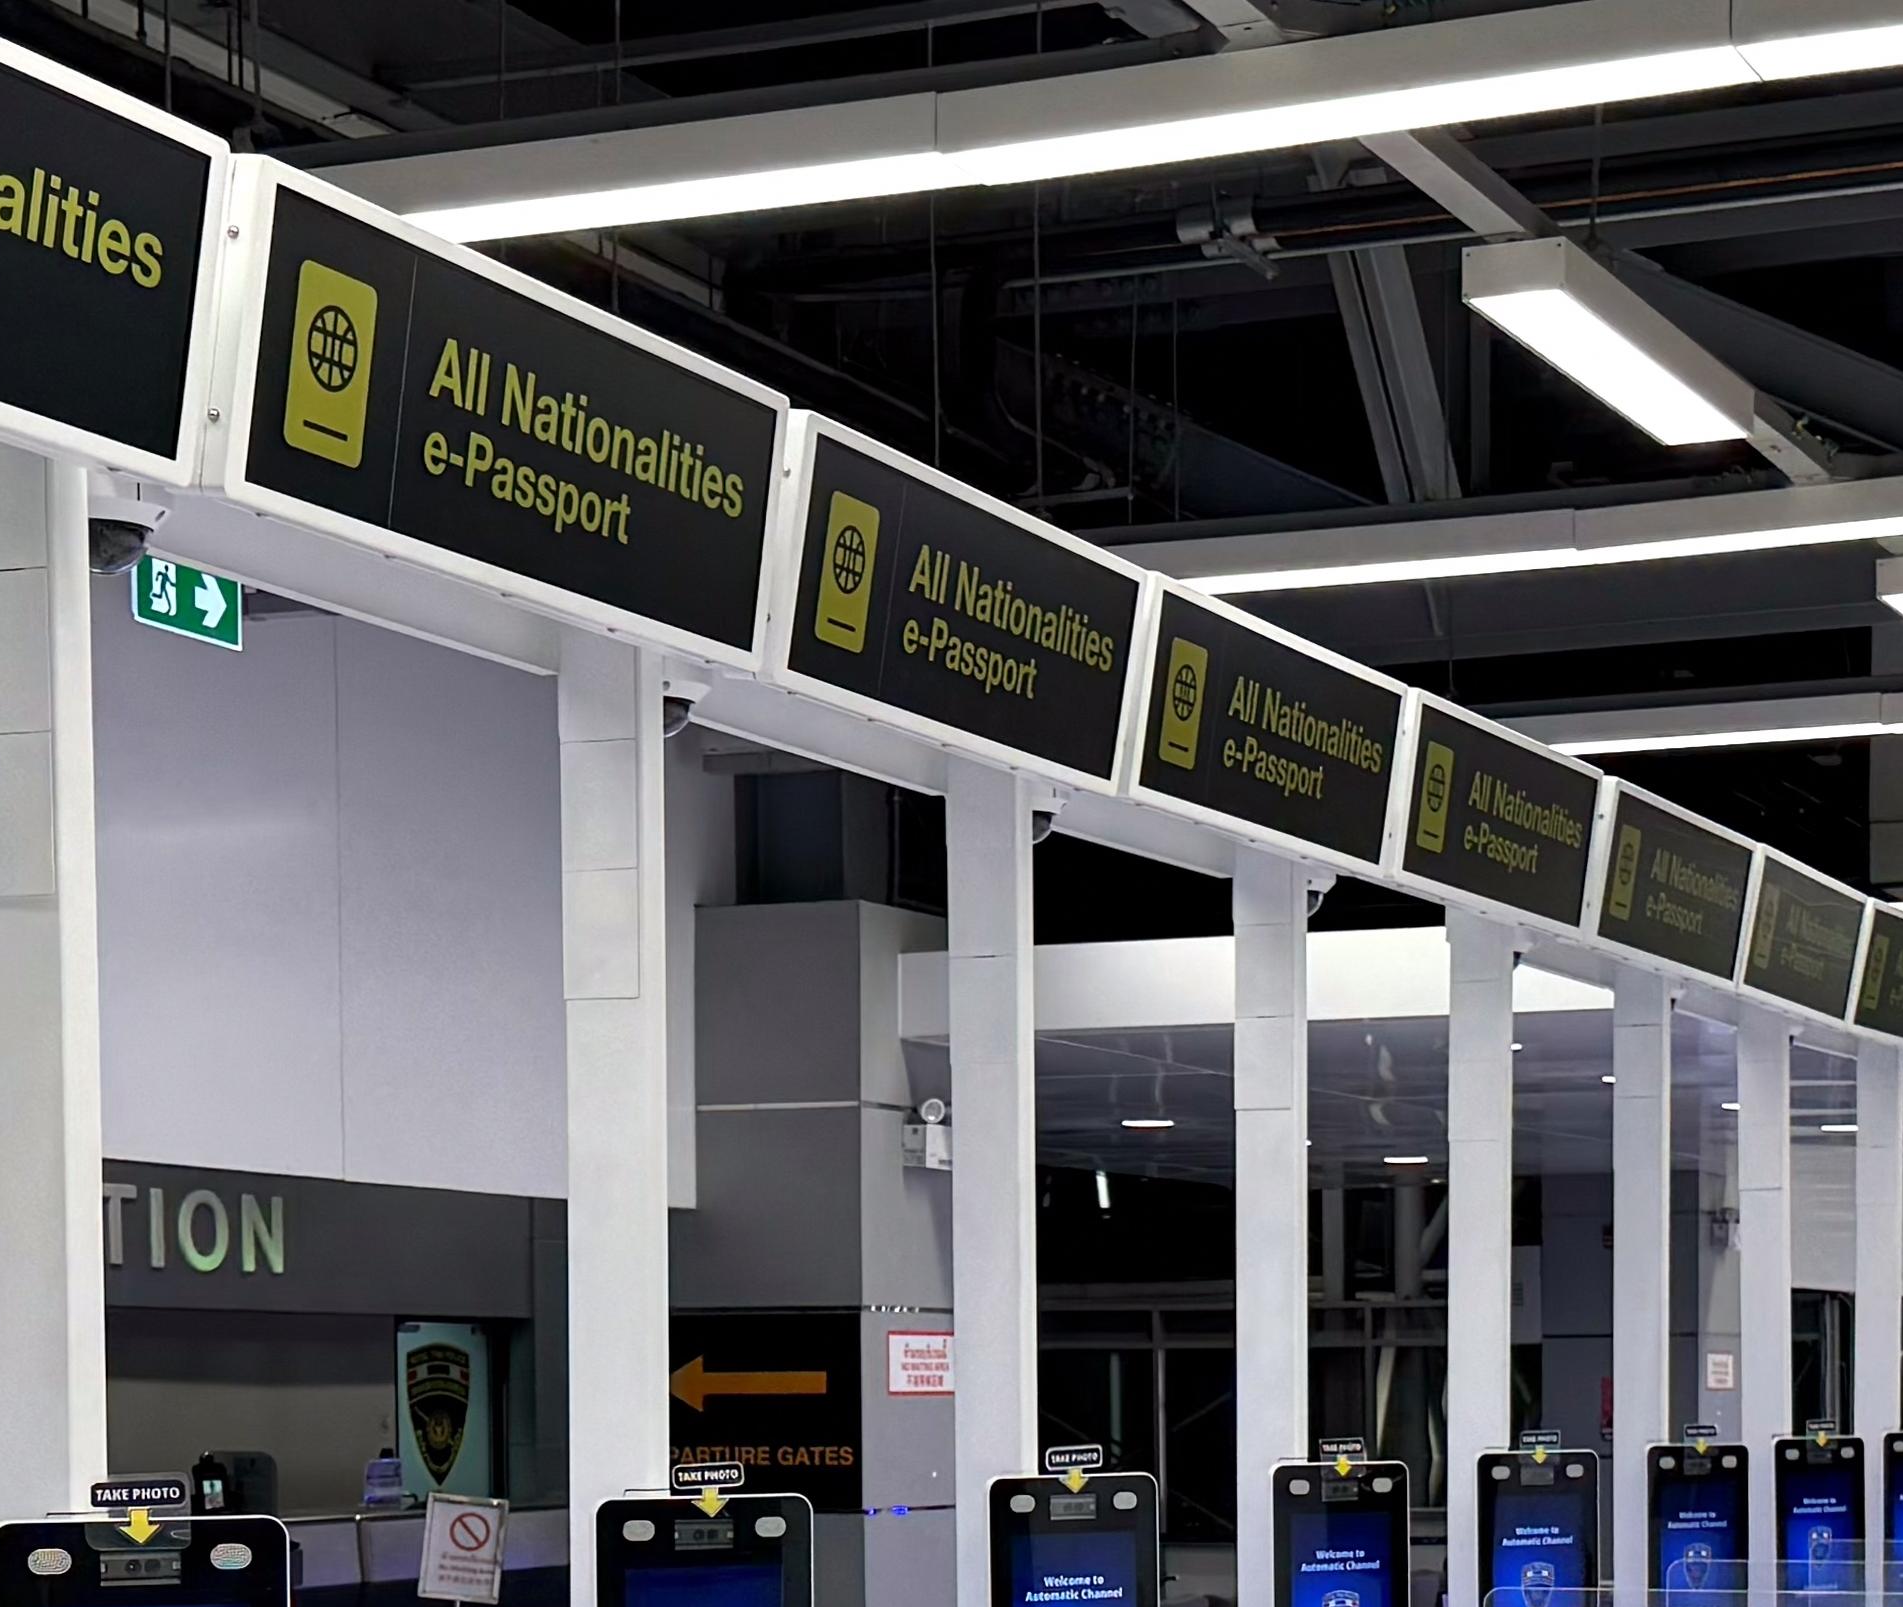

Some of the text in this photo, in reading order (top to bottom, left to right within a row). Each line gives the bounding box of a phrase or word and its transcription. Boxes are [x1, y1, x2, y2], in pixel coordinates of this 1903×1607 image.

[430, 337, 744, 519] All Nationalities
[423, 429, 631, 545] e-Passport
[908, 543, 1114, 673] All Nationalities
[902, 616, 1038, 701] e-Passport
[1228, 675, 1383, 775] All Nationalities
[1222, 736, 1325, 801] e-Passport
[1469, 770, 1584, 850] All Nationalities
[1463, 829, 1539, 875] e-Passport
[677, 1469, 739, 1482] TAKE PHOTO
[777, 1446, 854, 1466] GATES
[95, 1485, 180, 1502] TAKE PHOTO
[1025, 1587, 1123, 1602] Automatic Channel
[1043, 1575, 1105, 1588] Welcome to
